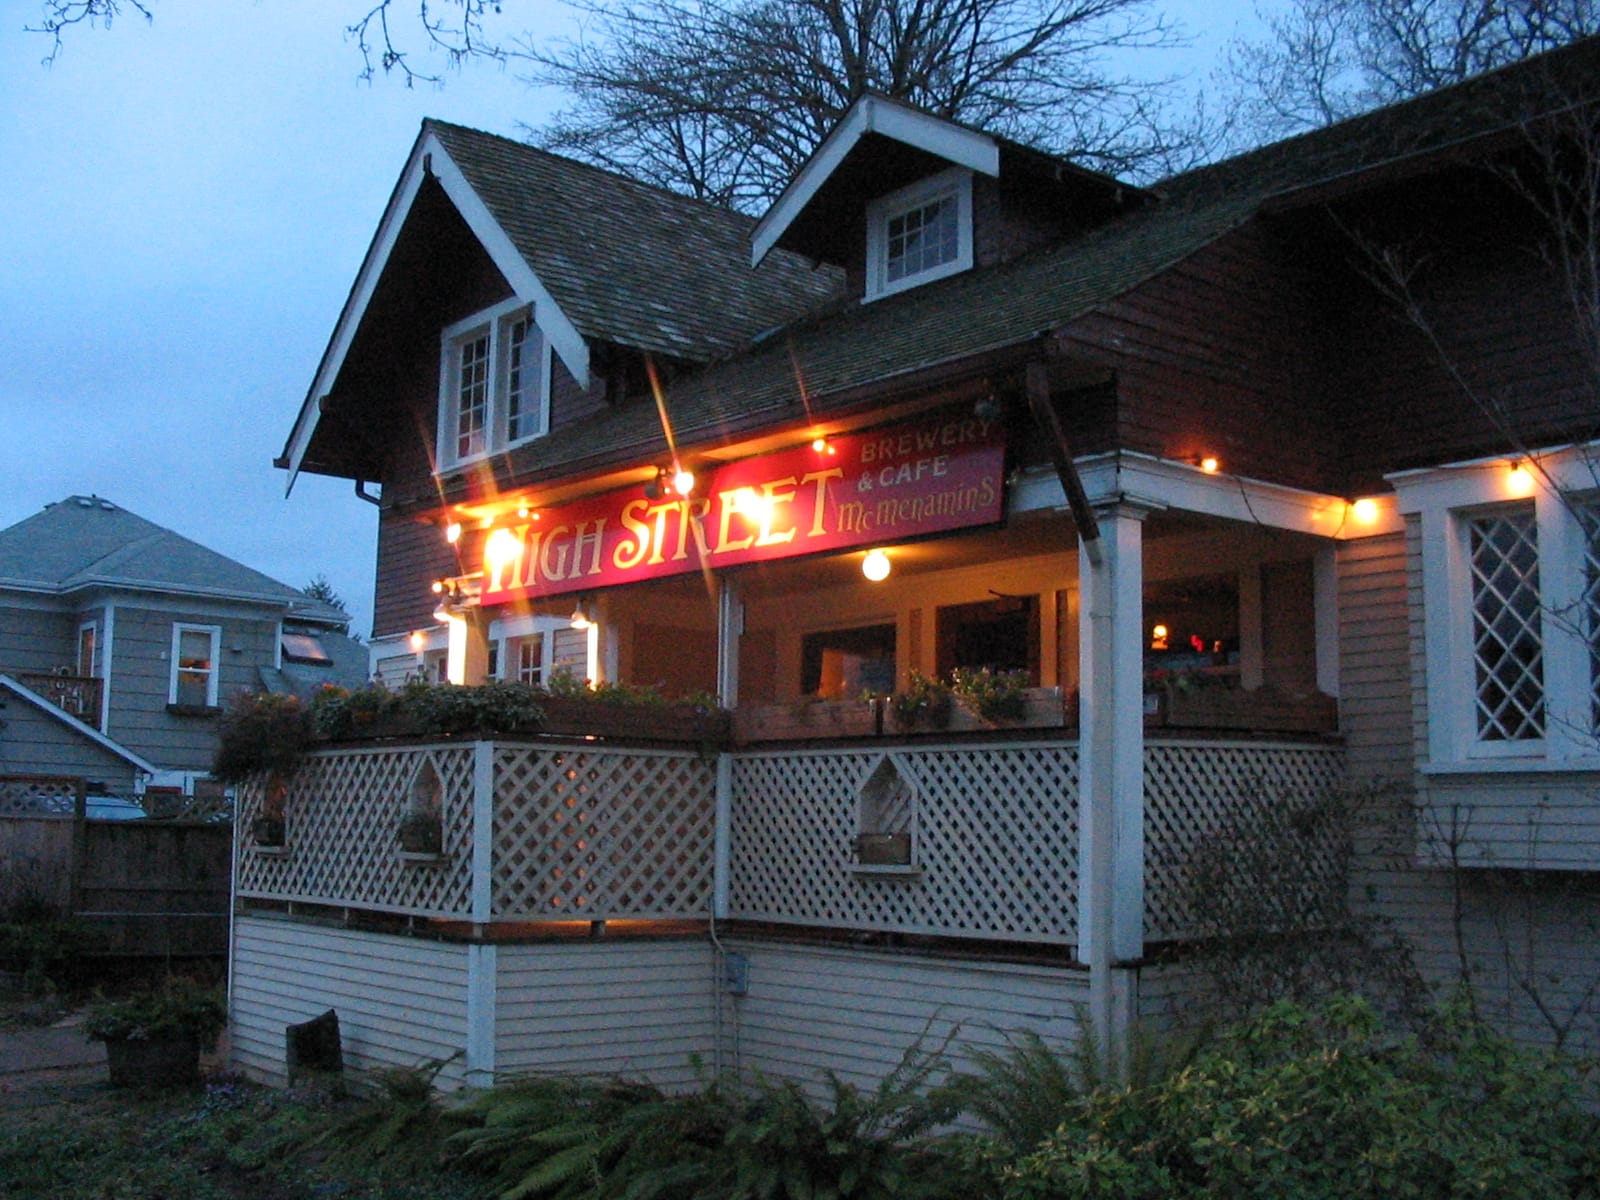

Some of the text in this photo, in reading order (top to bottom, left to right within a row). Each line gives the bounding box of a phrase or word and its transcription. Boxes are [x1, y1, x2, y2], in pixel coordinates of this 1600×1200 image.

[860, 420, 991, 463] BREWERY
[858, 455, 950, 492] & CAFE
[486, 467, 843, 593] HIGH STREET
